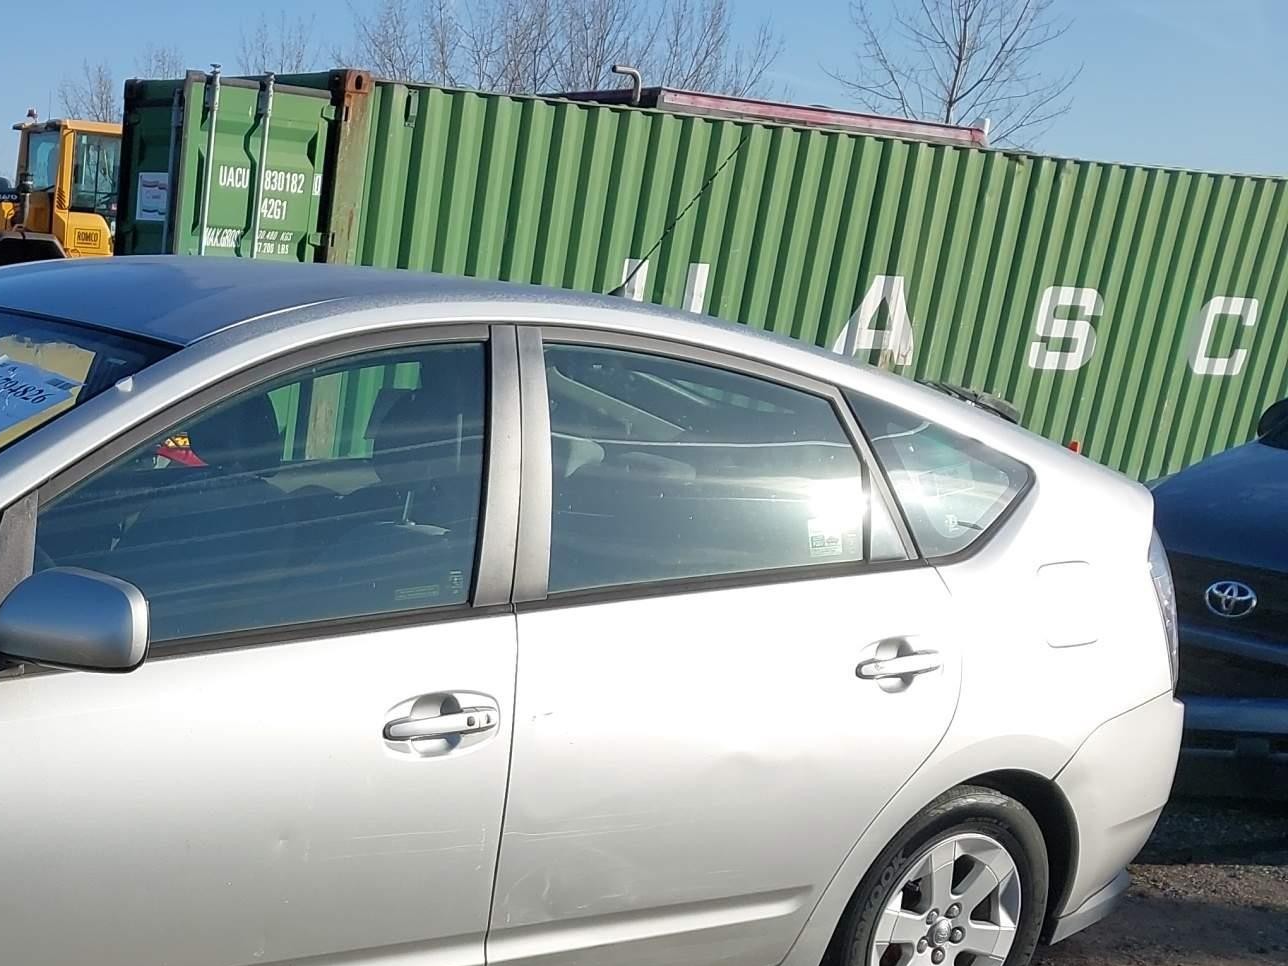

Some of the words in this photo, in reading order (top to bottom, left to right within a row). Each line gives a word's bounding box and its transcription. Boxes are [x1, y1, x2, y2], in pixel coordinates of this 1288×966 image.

[219, 165, 250, 189] UACU
[264, 169, 305, 194] 830182
[261, 197, 288, 221] 42G1
